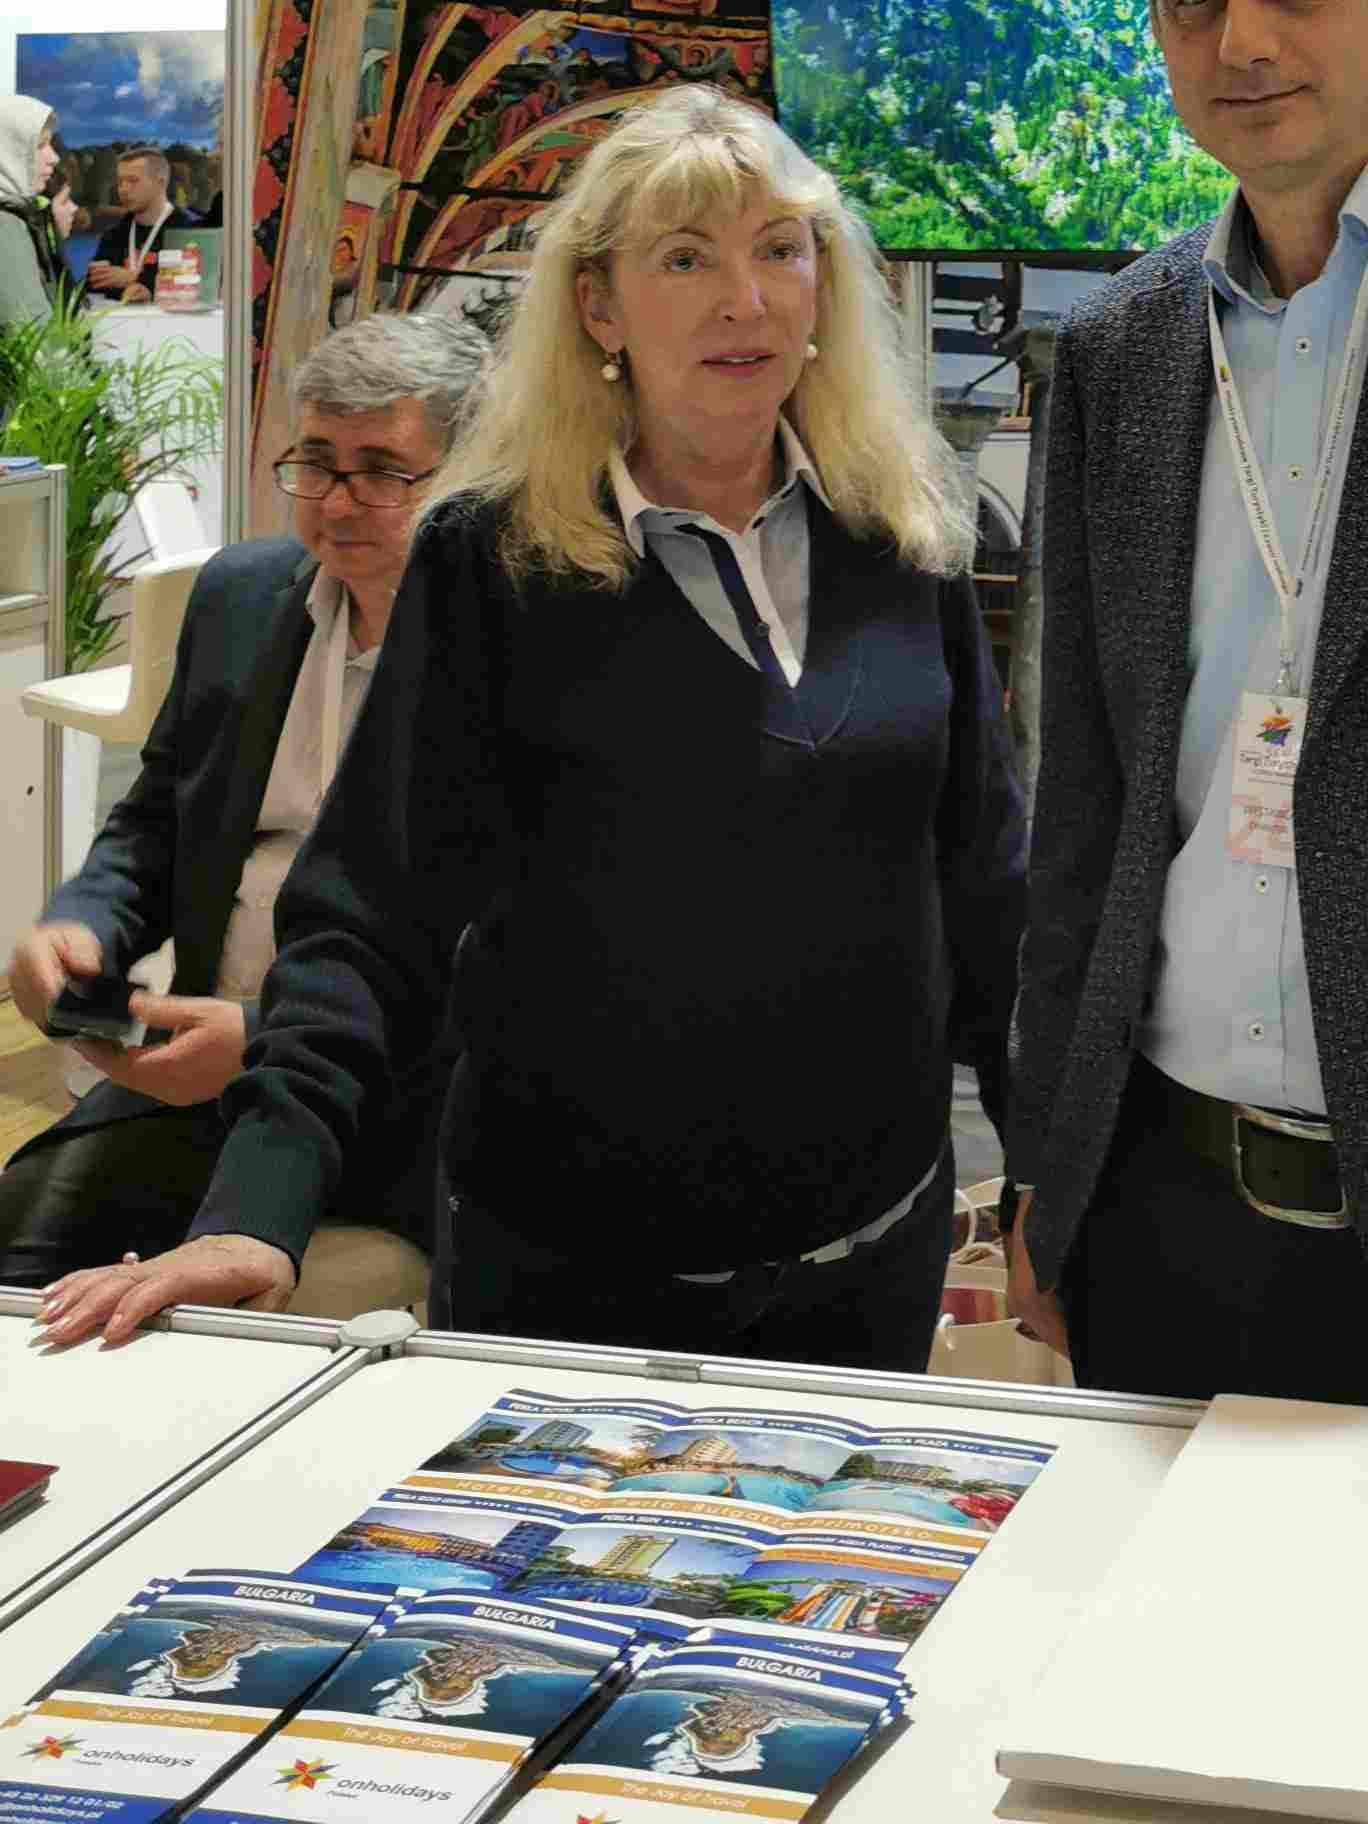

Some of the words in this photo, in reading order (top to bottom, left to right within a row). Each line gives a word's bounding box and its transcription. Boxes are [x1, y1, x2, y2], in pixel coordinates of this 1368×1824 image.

[233, 1584, 316, 1607] BULGARIA
[472, 1605, 557, 1631] BULGARIA
[735, 1656, 823, 1682] BULGARIA
[83, 1747, 196, 1768] onholidays
[337, 1778, 453, 1802] onholidays
